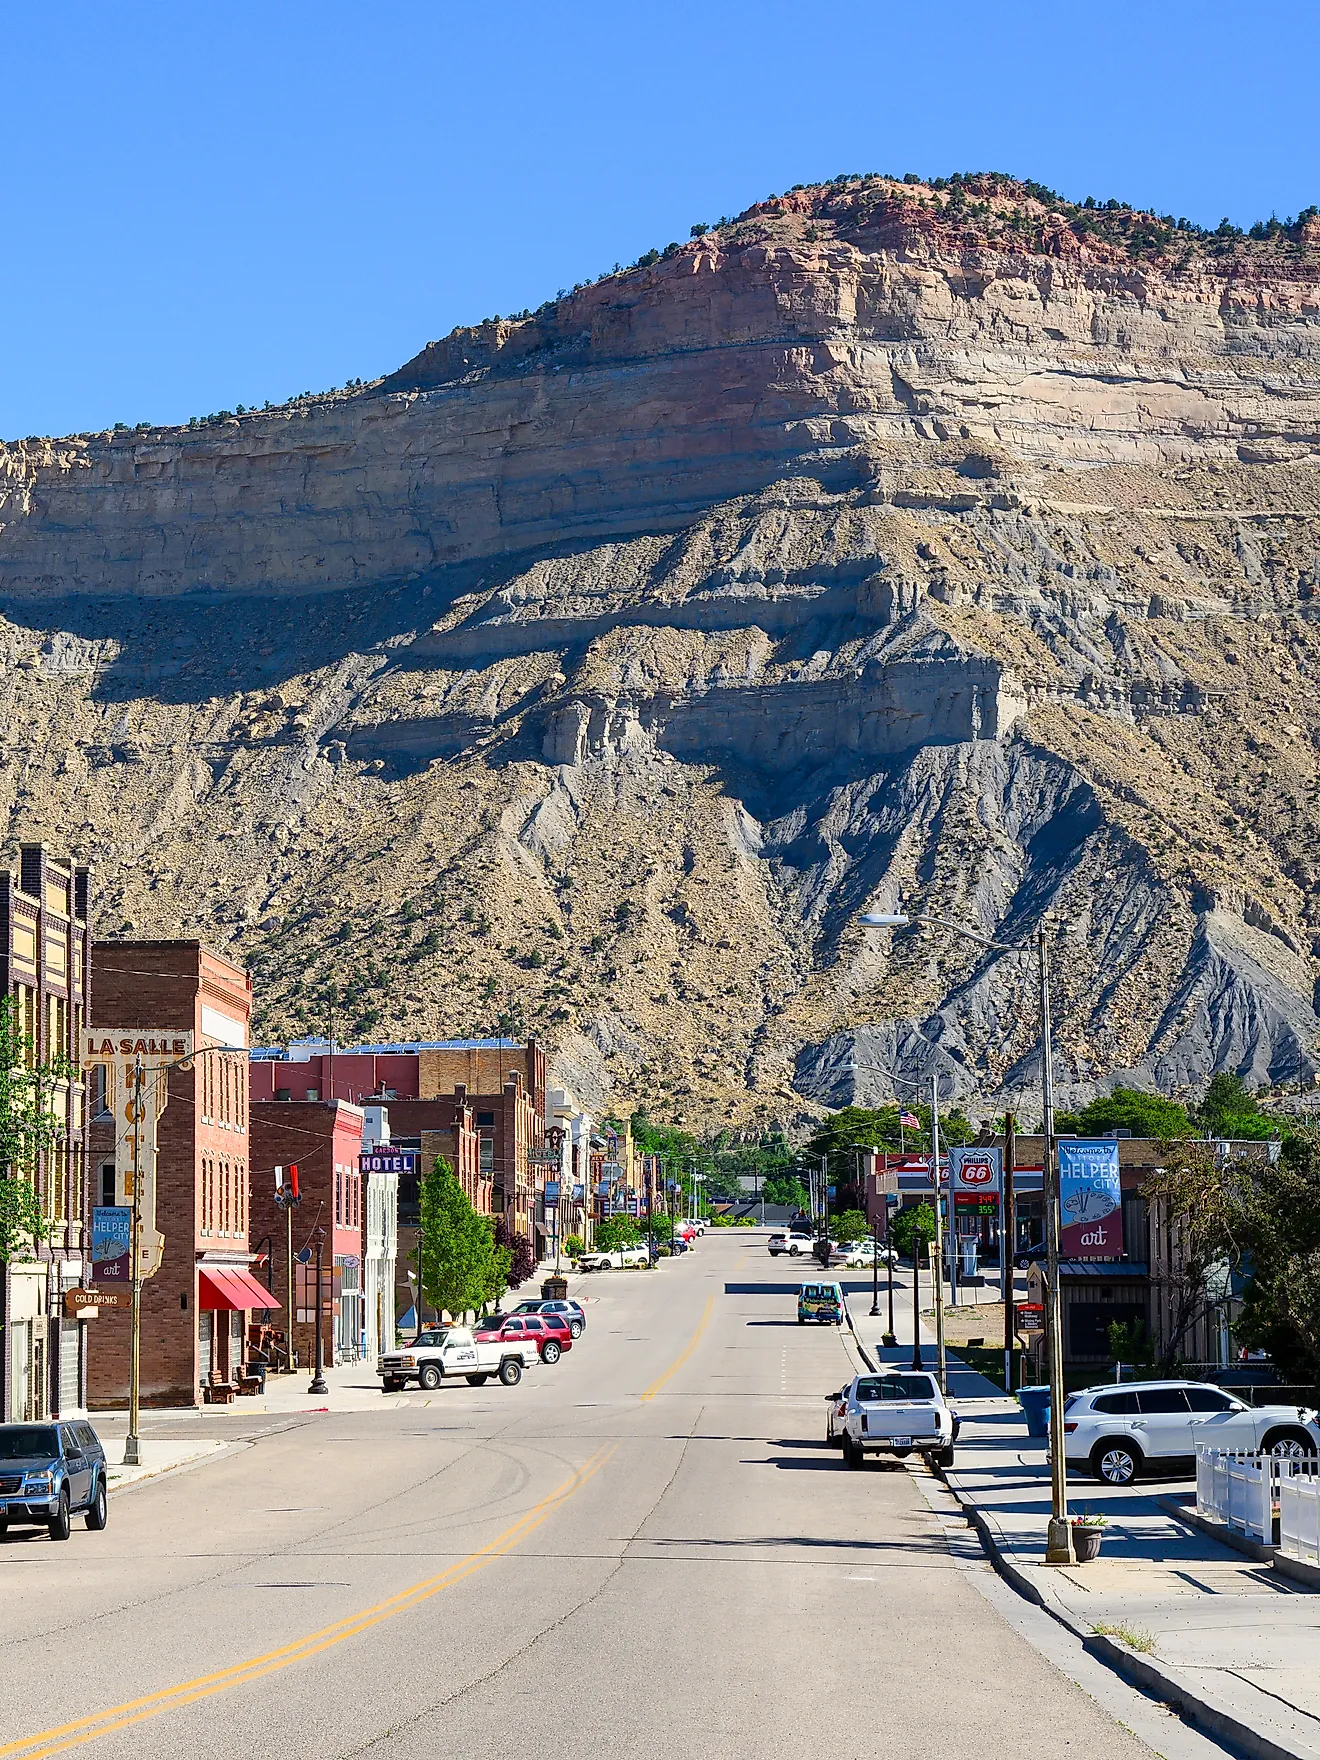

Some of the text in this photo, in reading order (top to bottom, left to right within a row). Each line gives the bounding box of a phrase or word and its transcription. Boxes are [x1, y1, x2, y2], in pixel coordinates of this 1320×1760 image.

[88, 1038, 185, 1055] LA SALLE
[124, 1063, 146, 1232] HOTE
[1062, 1145, 1113, 1155] Welcome to
[361, 1157, 412, 1171] HOTEL
[965, 1166, 987, 1179] 66
[1060, 1163, 1119, 1179] HELPER
[1093, 1179, 1119, 1189] CITY
[93, 1222, 129, 1232] HELPER
[113, 1232, 130, 1240] CITY
[1080, 1225, 1108, 1246] art
[103, 1262, 121, 1276] art
[74, 1293, 118, 1305] COLD DRINKS
